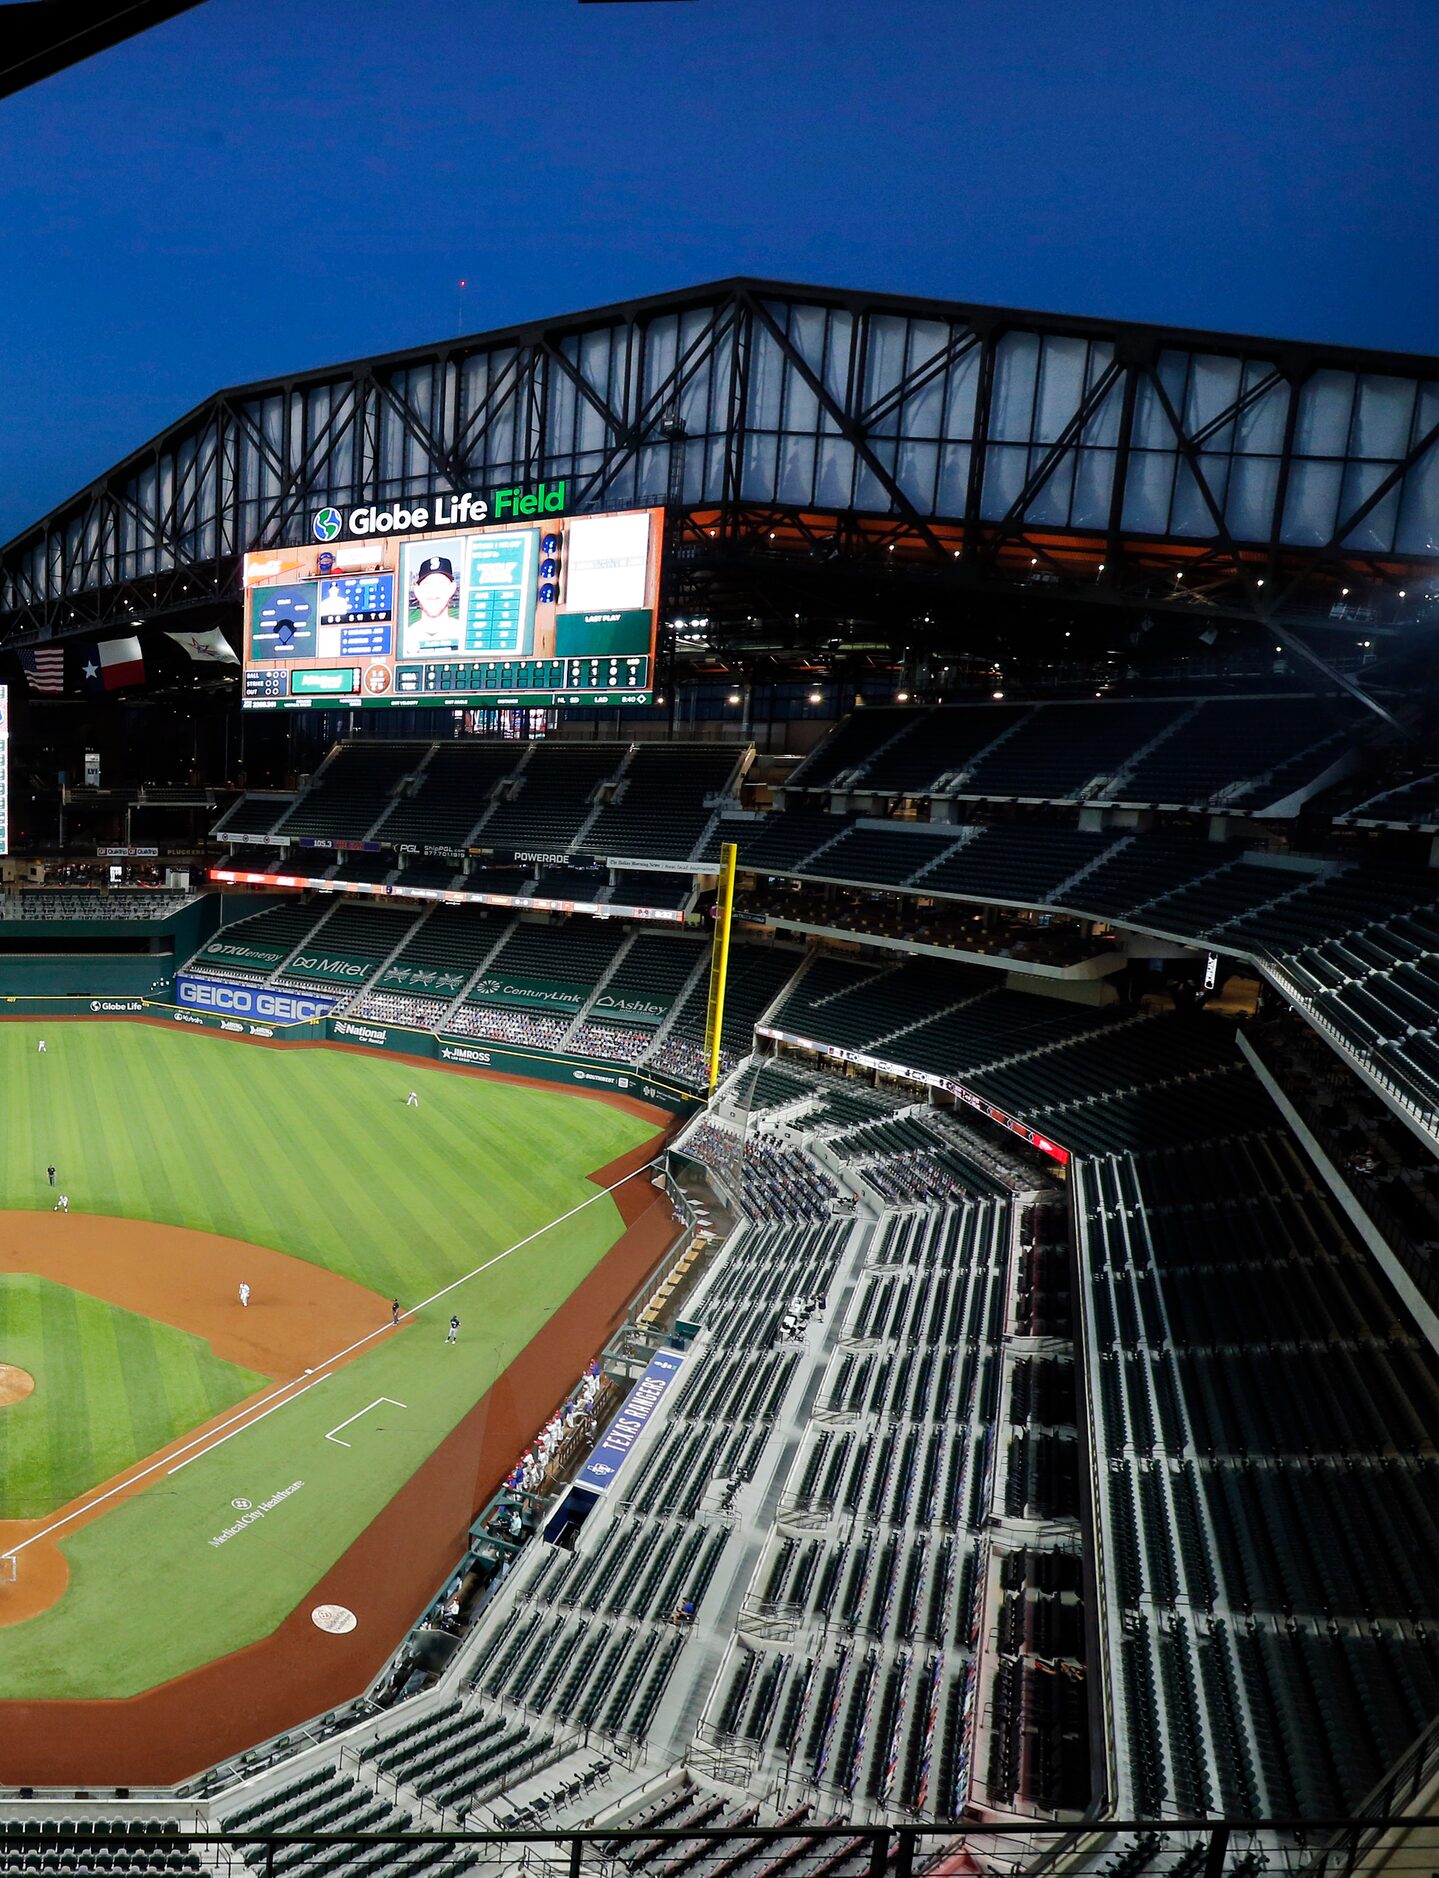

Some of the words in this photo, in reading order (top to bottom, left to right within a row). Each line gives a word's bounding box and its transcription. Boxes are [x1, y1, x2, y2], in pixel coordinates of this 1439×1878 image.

[348, 503, 429, 536] Globe
[434, 492, 488, 526] Life
[494, 480, 565, 518] Field
[313, 839, 332, 848] 105.3
[400, 844, 420, 853] PGL
[514, 852, 570, 865] POWERADE
[317, 959, 370, 977] Mitel
[180, 982, 252, 1011] GEICO
[503, 985, 580, 1004] CenturyLink
[102, 1002, 126, 1011] Globe
[127, 1002, 142, 1011] Life
[613, 1000, 669, 1016] Ashley
[602, 1417, 642, 1453] TEXAS
[624, 1376, 666, 1420] RANGERS
[208, 1519, 249, 1548] Medical
[241, 1508, 265, 1525] City
[257, 1480, 305, 1512] Healthcare
